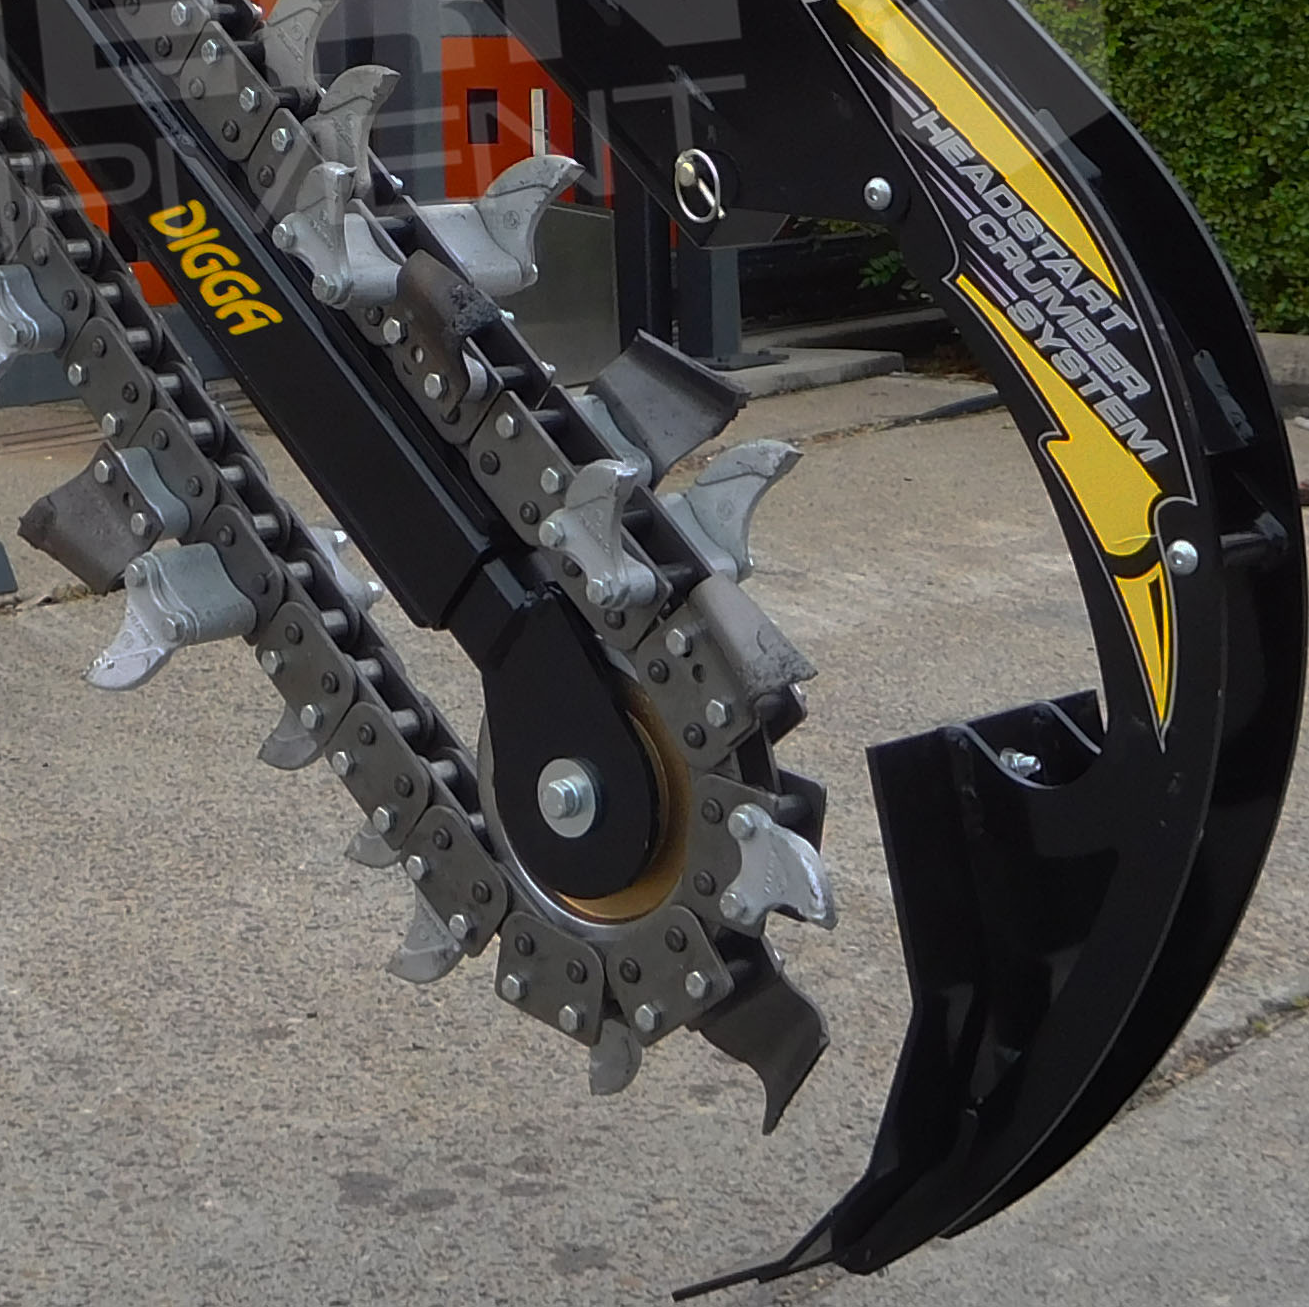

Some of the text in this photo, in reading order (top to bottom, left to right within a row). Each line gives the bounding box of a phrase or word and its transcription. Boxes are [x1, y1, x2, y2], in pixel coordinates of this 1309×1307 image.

[148, 199, 283, 335] DIGGA
[912, 109, 1138, 331] HEADSTART
[968, 215, 1151, 401] CRUMBER
[1007, 299, 1168, 463] SYSTEM
